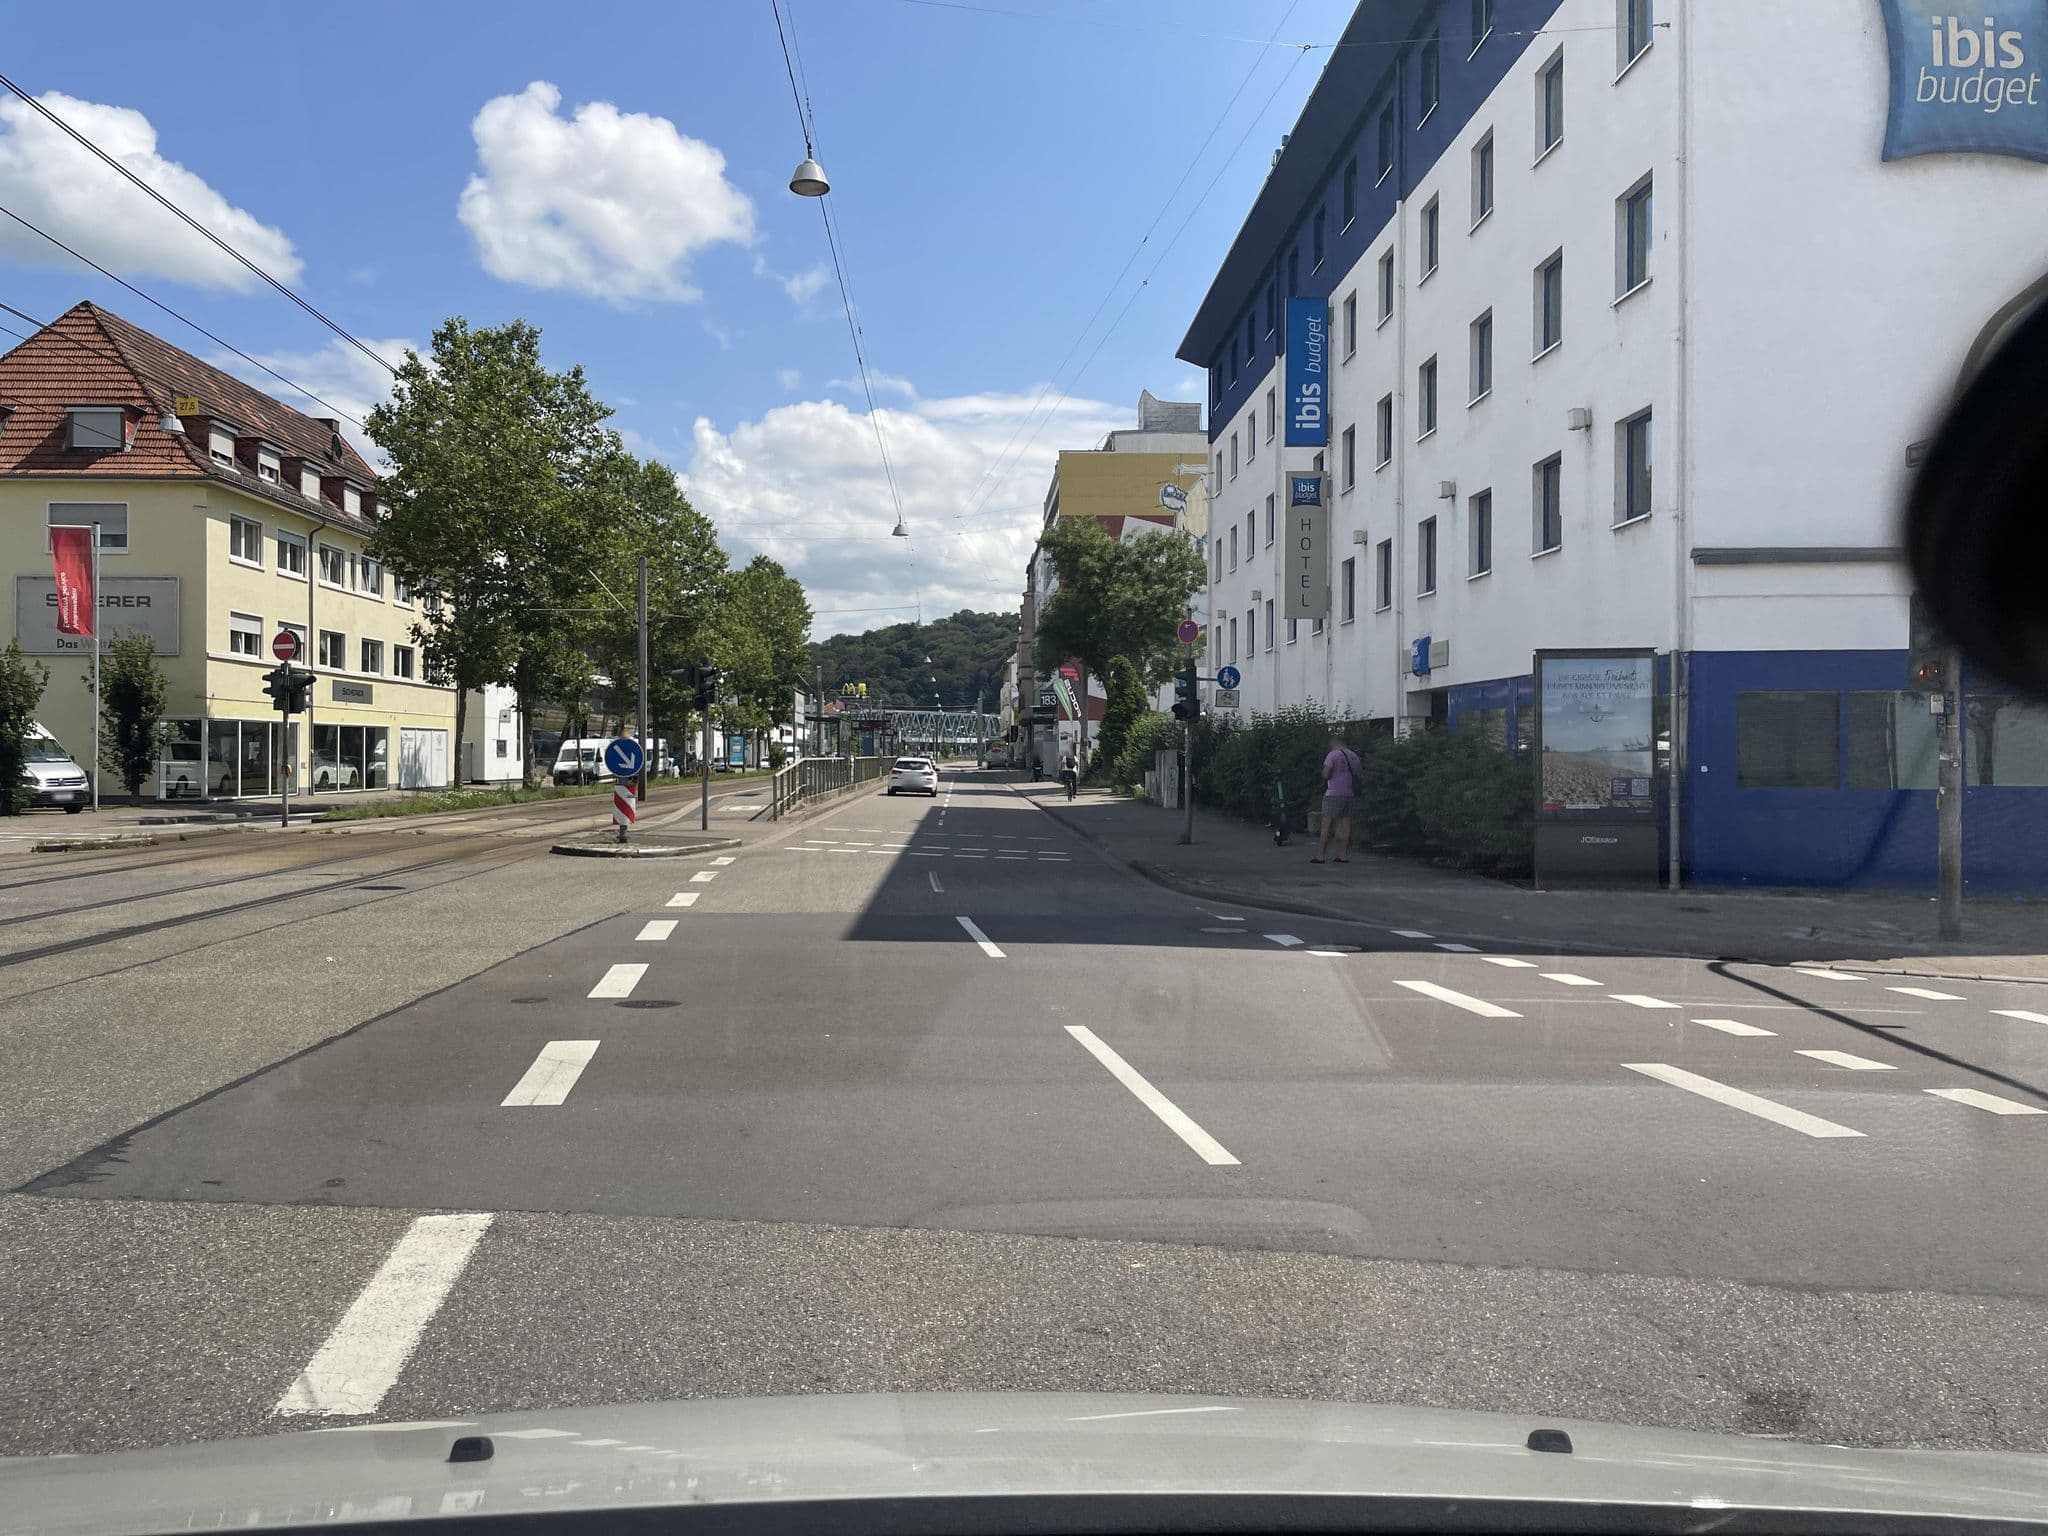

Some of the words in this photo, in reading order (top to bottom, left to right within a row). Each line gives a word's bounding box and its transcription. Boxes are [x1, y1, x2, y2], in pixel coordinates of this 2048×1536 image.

[1932, 16, 2024, 69] ibis
[1916, 66, 2040, 113] budget
[1304, 316, 1325, 373] budget
[1295, 383, 1321, 429] ibis
[1298, 482, 1315, 493] ibis
[1300, 518, 1312, 608] HOTEL
[56, 639, 78, 648] Das
[1041, 695, 1057, 706] 183
